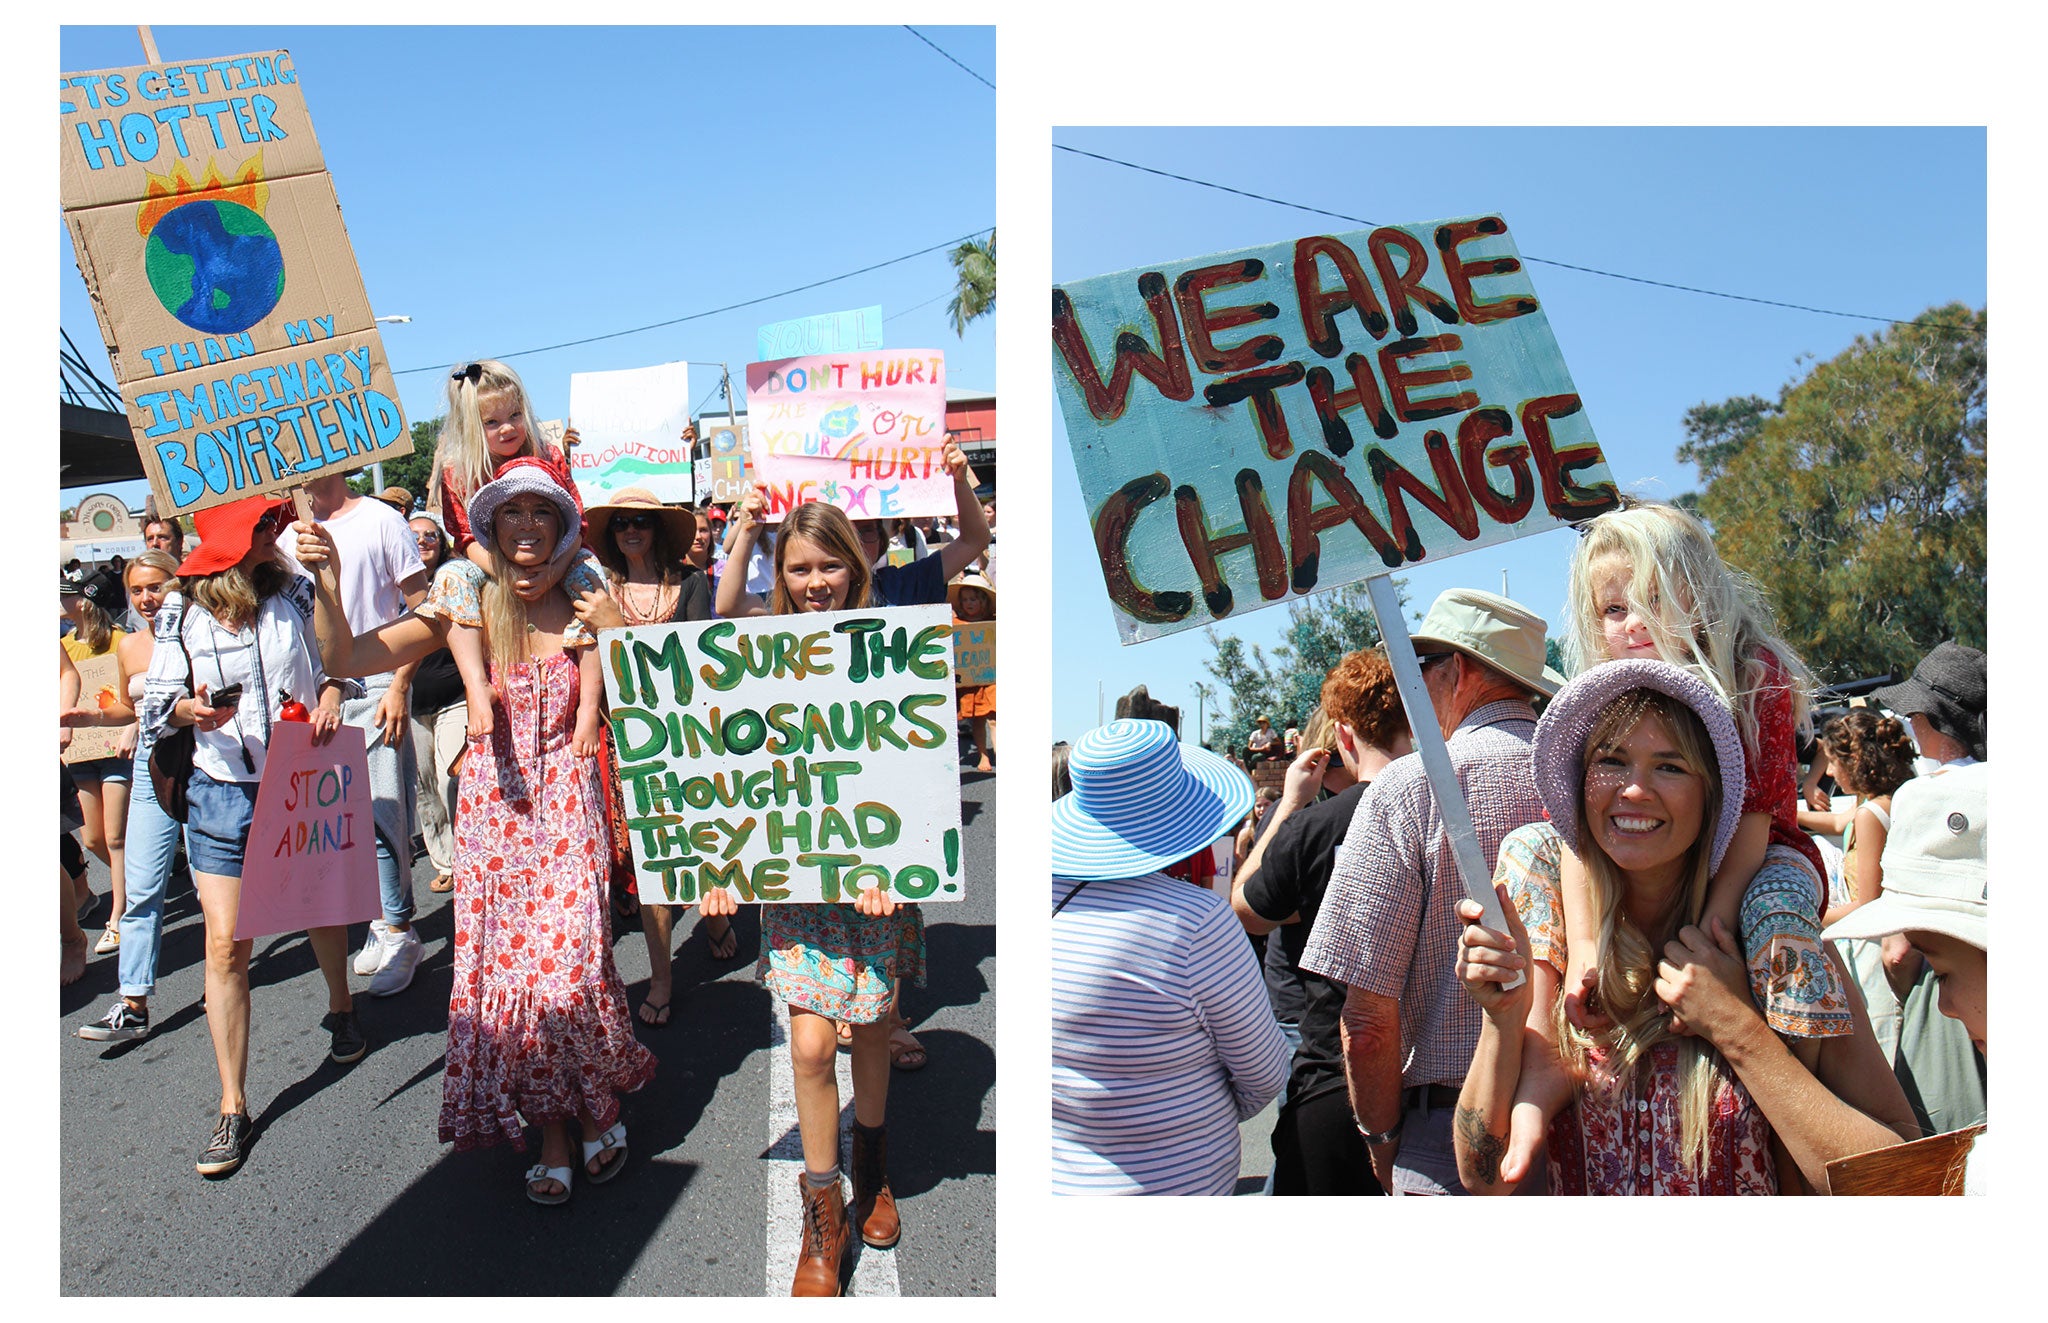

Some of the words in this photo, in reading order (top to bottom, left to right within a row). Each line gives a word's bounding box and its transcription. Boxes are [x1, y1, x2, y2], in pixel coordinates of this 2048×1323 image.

[137, 54, 297, 101] GETTING
[76, 94, 288, 169] HOTTER
[141, 332, 256, 376] THAN
[284, 314, 334, 346] MY
[759, 311, 878, 361] YOU'LL
[1052, 259, 1286, 422] WE
[1294, 216, 1538, 358] ARE
[135, 346, 371, 438] IMAGINARY
[861, 357, 943, 390] HURT
[1204, 333, 1481, 461] THE
[155, 390, 402, 508] BOYFRIEND
[572, 442, 687, 469] REVOLUTION!
[762, 430, 831, 457] YOUR
[714, 479, 757, 500] CHA
[1093, 394, 1622, 622] CHANGE
[105, 546, 136, 554] CORNER
[82, 666, 106, 680] THE
[610, 630, 694, 709] I'M
[698, 621, 835, 692] SURE
[834, 618, 952, 682] THE
[611, 694, 947, 761] DINOSAURS
[285, 764, 352, 811] STOP
[619, 756, 862, 817] THOUGHT
[274, 813, 355, 857] ADANI
[628, 812, 757, 860] THEY
[767, 801, 901, 854] HAD
[642, 855, 791, 902] TIME
[797, 827, 958, 902] TOO!
